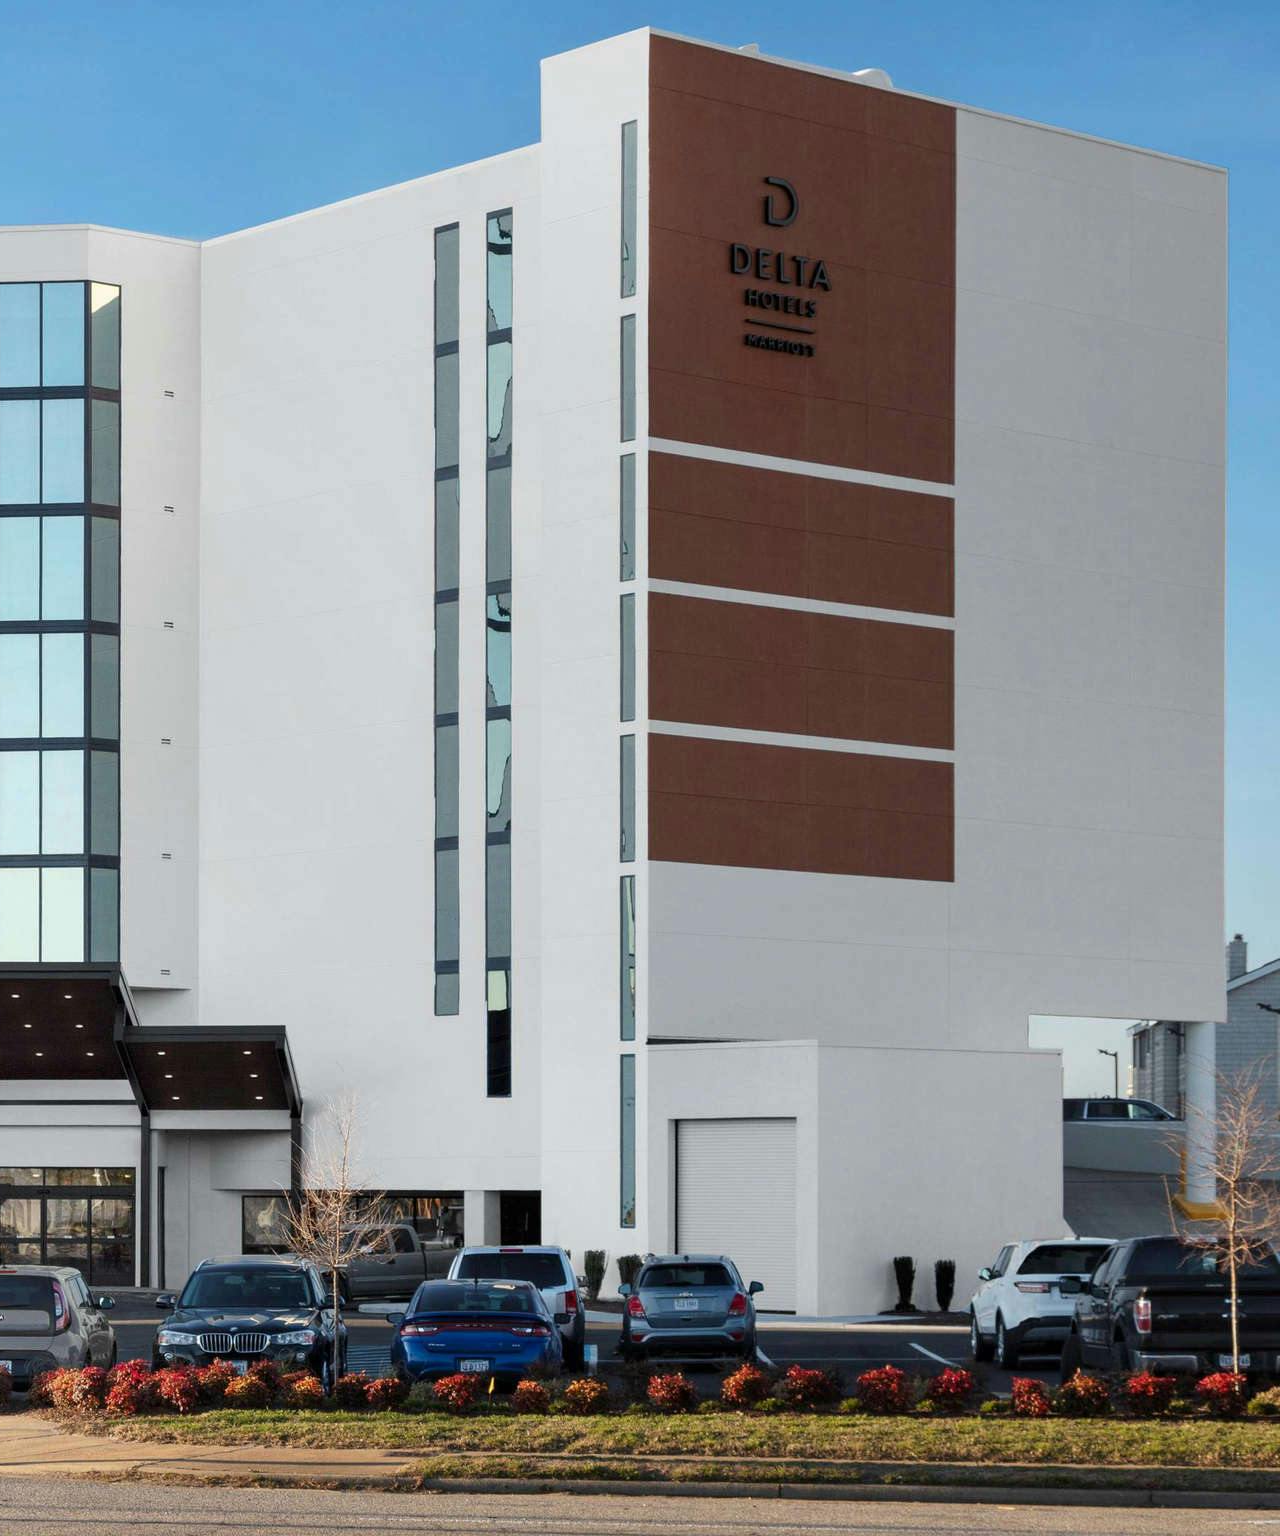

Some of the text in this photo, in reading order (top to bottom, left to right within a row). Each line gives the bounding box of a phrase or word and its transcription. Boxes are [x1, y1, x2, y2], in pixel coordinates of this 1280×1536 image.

[730, 242, 832, 291] DELTA
[744, 288, 816, 318] HOTELS
[744, 334, 815, 358] MARRIOTT
